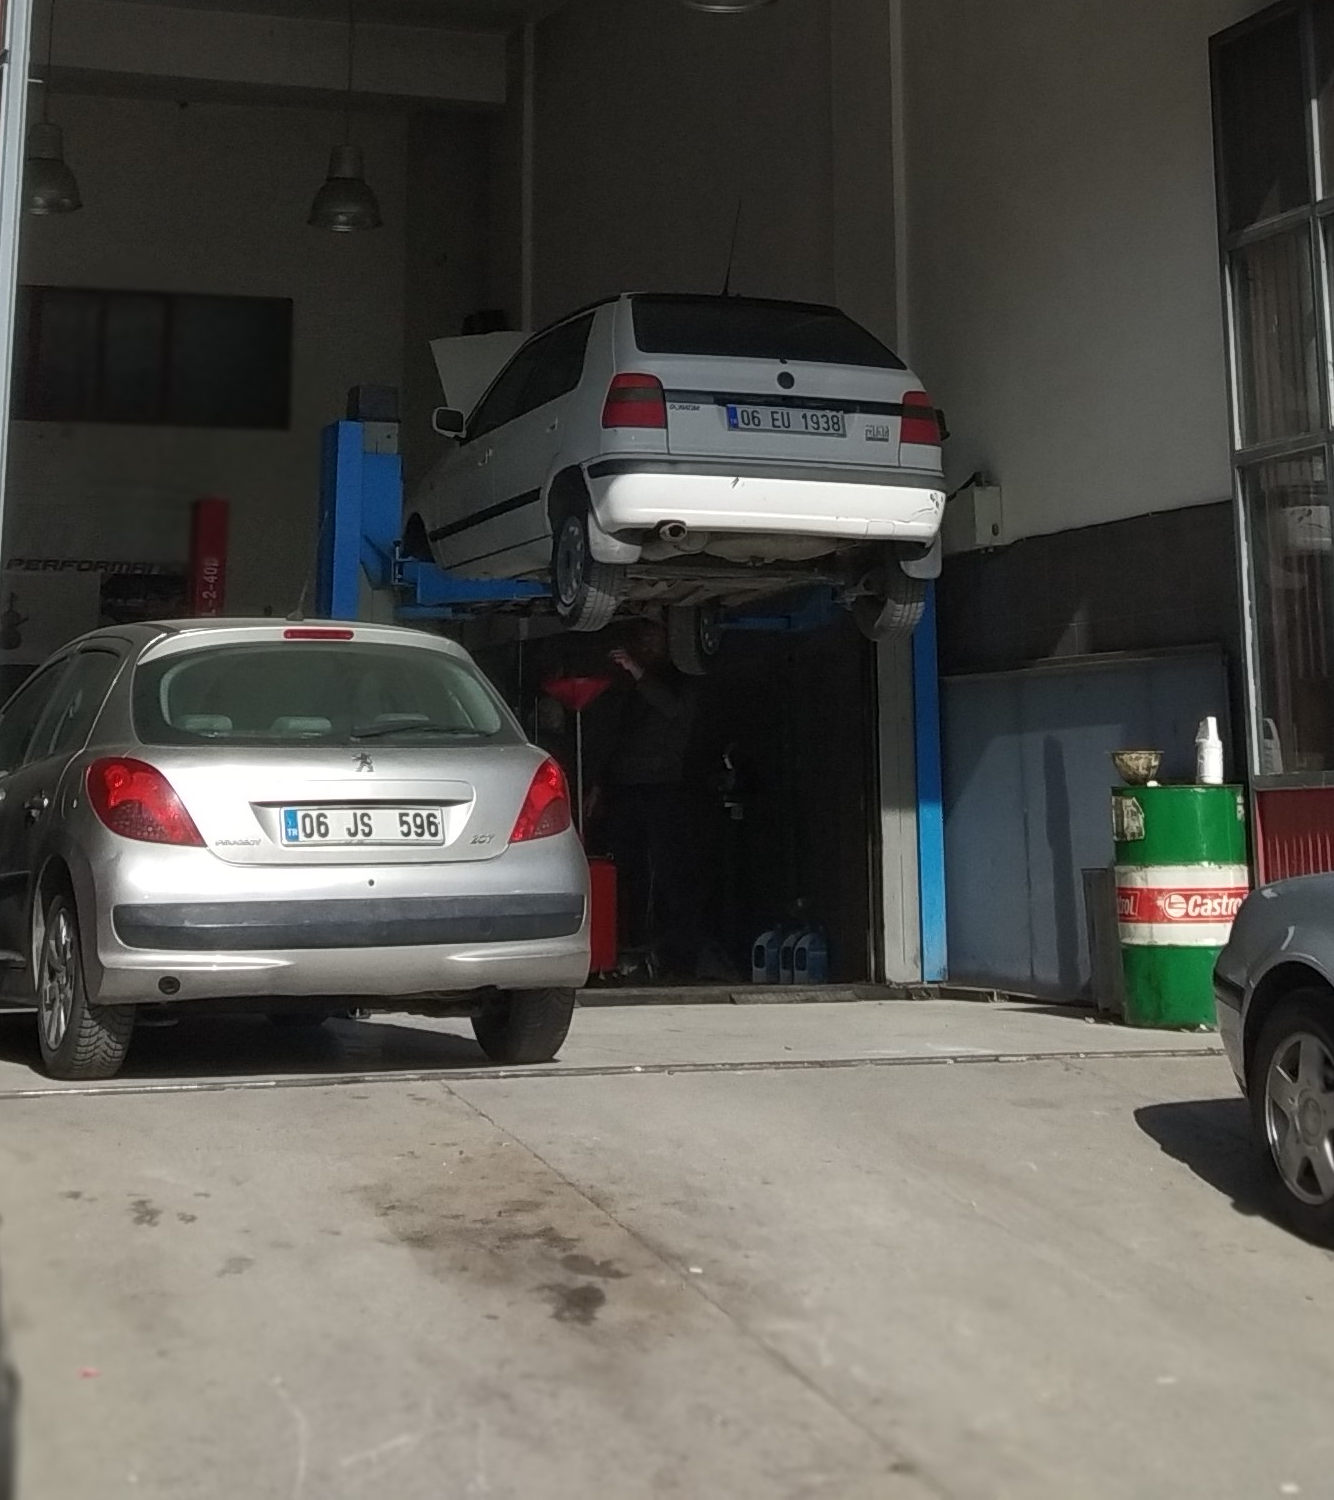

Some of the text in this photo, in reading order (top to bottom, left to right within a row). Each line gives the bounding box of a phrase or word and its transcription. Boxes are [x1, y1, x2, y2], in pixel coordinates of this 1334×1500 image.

[740, 408, 762, 428] 06
[771, 410, 792, 429] EU
[801, 413, 842, 433] 1938
[287, 810, 439, 839] TR 06 JS 596
[1187, 894, 1244, 917] Castro
